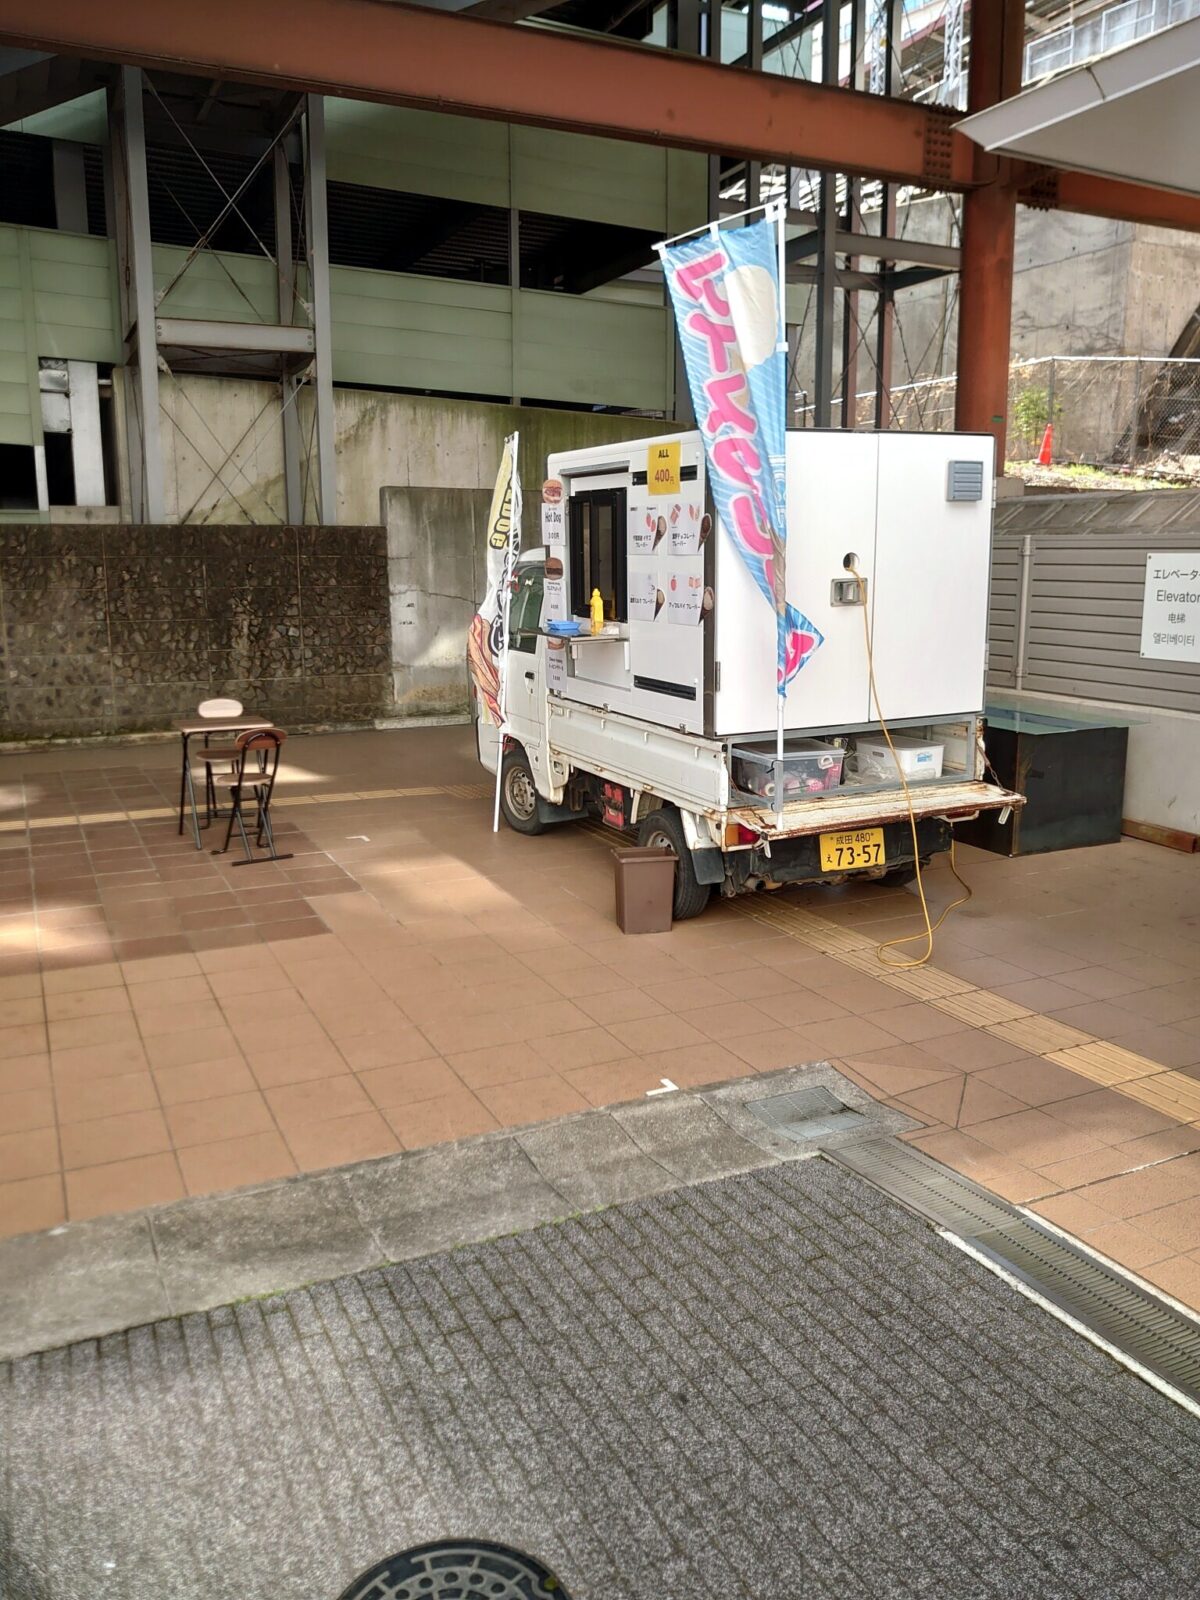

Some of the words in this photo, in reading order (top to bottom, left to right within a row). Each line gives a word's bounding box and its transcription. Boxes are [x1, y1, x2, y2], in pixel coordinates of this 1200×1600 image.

[658, 449, 670, 459] ALL
[1153, 569, 1200, 580] エレベータ
[1168, 613, 1186, 623] 电梯
[836, 834, 853, 845] 成田
[855, 833, 871, 843] 480
[835, 844, 881, 867] 73-57
